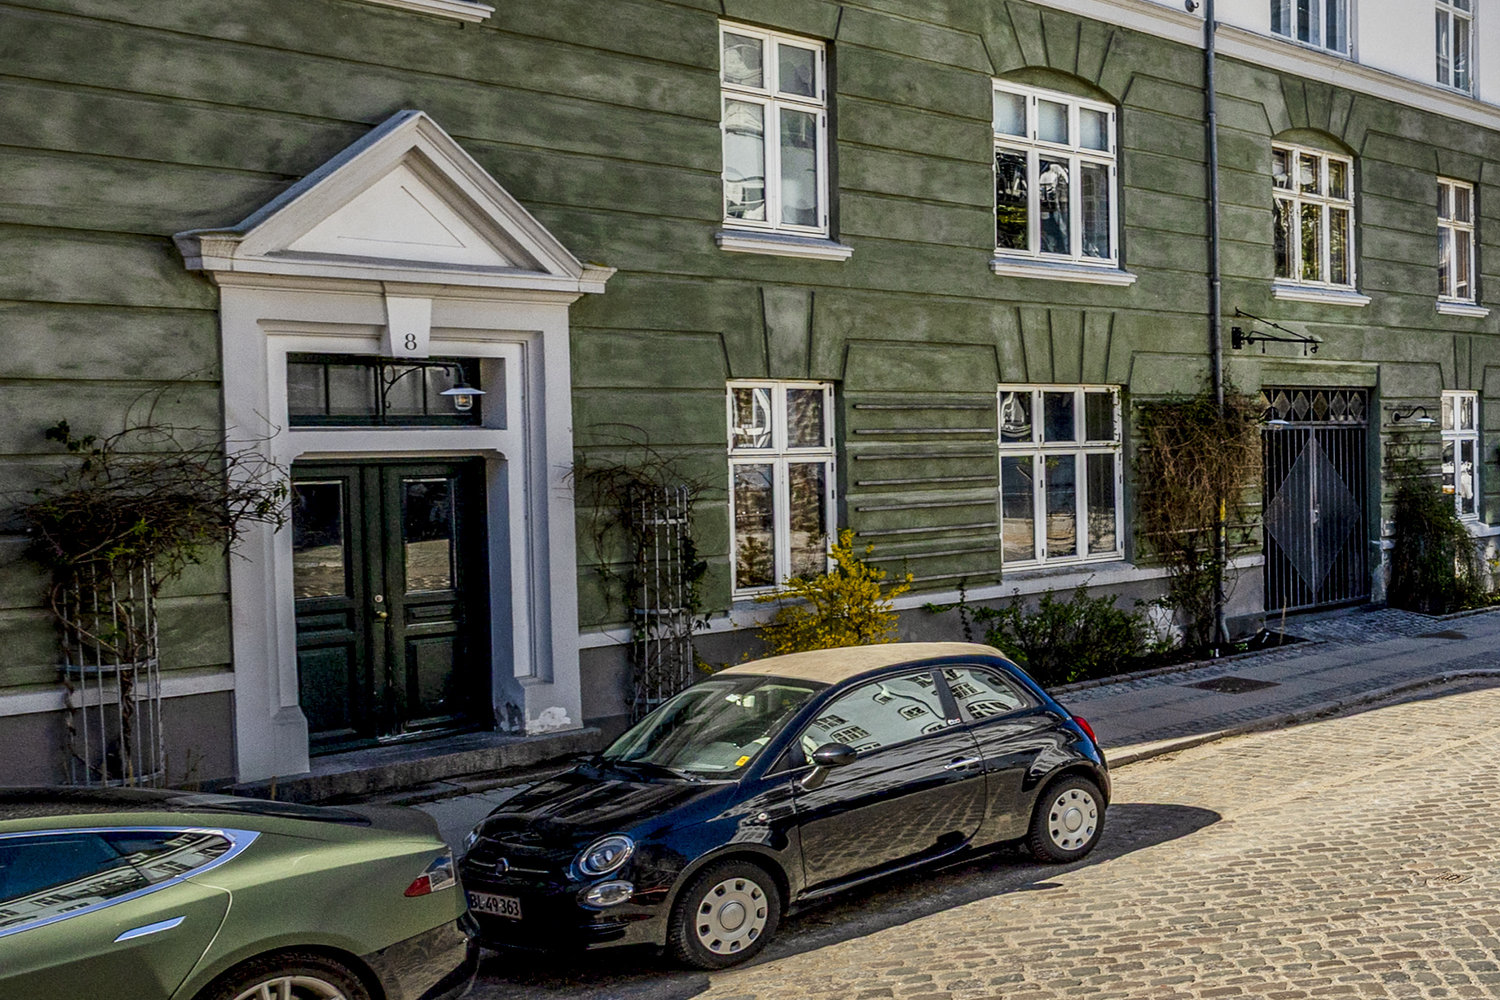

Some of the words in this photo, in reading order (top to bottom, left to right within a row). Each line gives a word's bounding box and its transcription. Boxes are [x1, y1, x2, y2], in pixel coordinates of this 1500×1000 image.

[404, 332, 417, 351] 8
[486, 896, 499, 912] 49
[500, 898, 520, 916] 363
